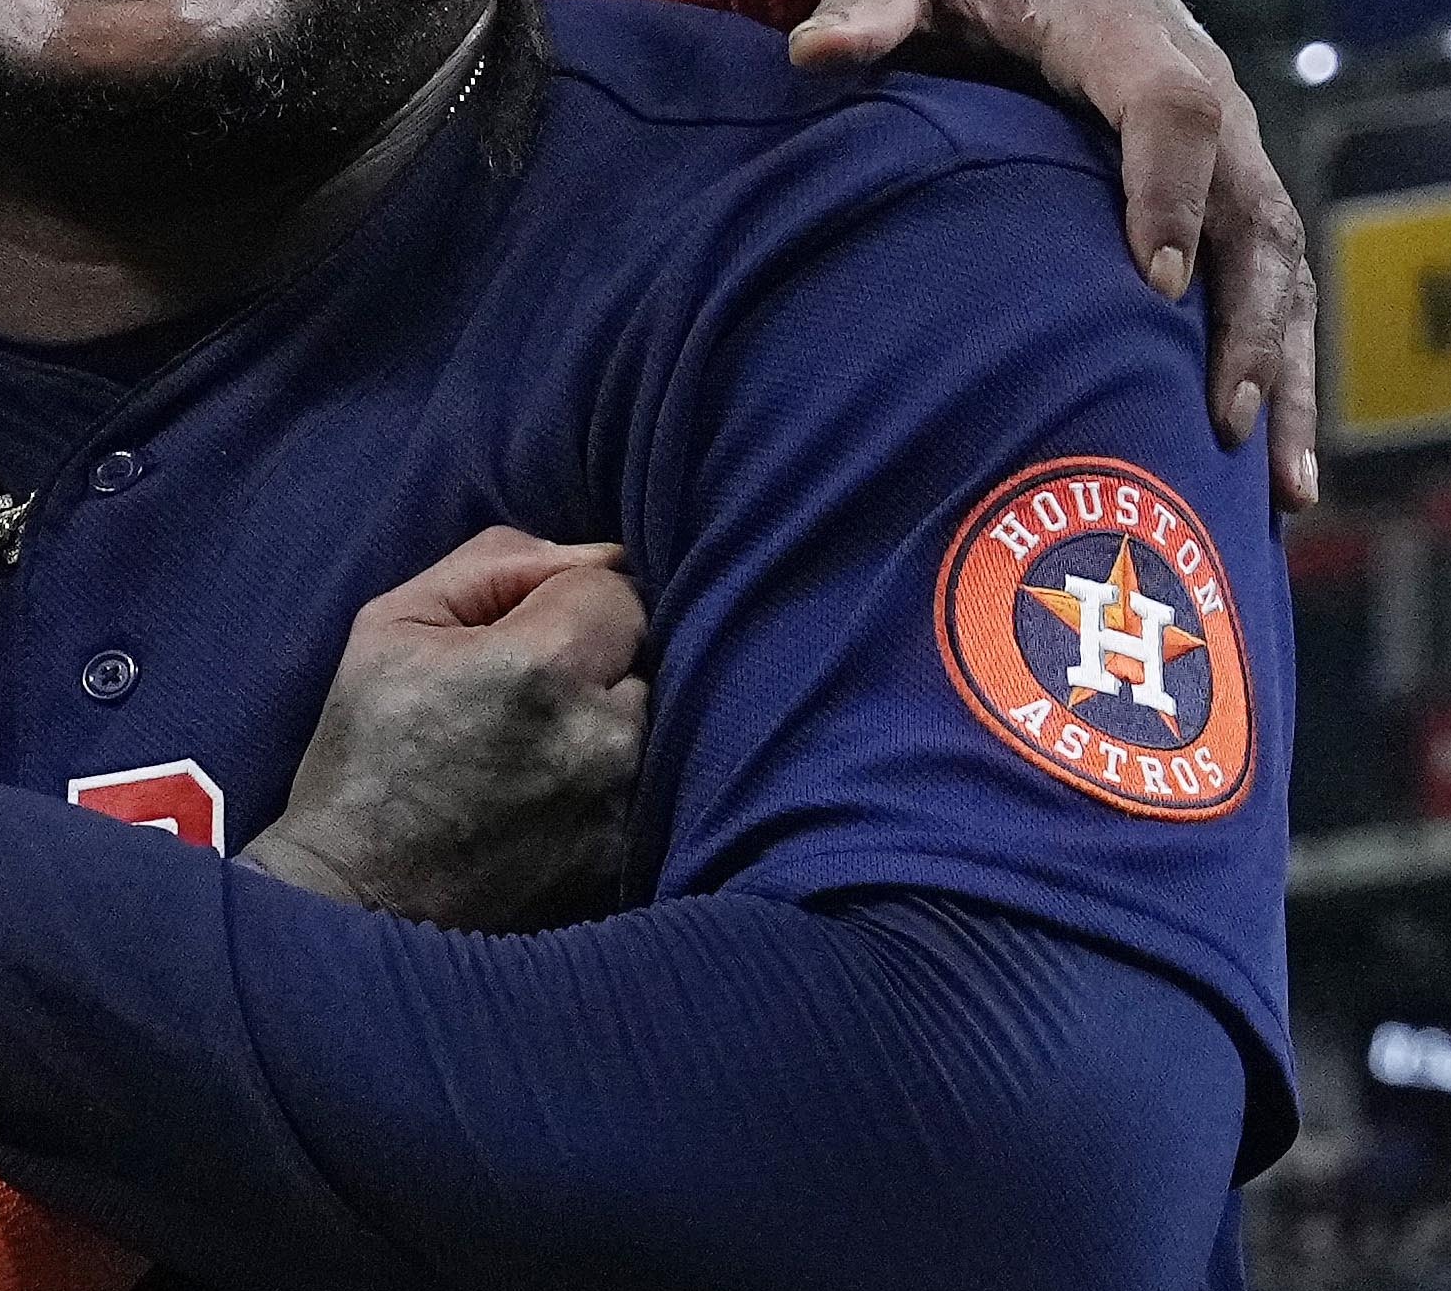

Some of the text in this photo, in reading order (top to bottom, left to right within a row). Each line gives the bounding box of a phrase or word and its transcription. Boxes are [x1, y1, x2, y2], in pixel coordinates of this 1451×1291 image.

[990, 482, 1225, 617] HOUSTON
[1064, 573, 1178, 717] H
[1010, 698, 1225, 796] ASTROS
